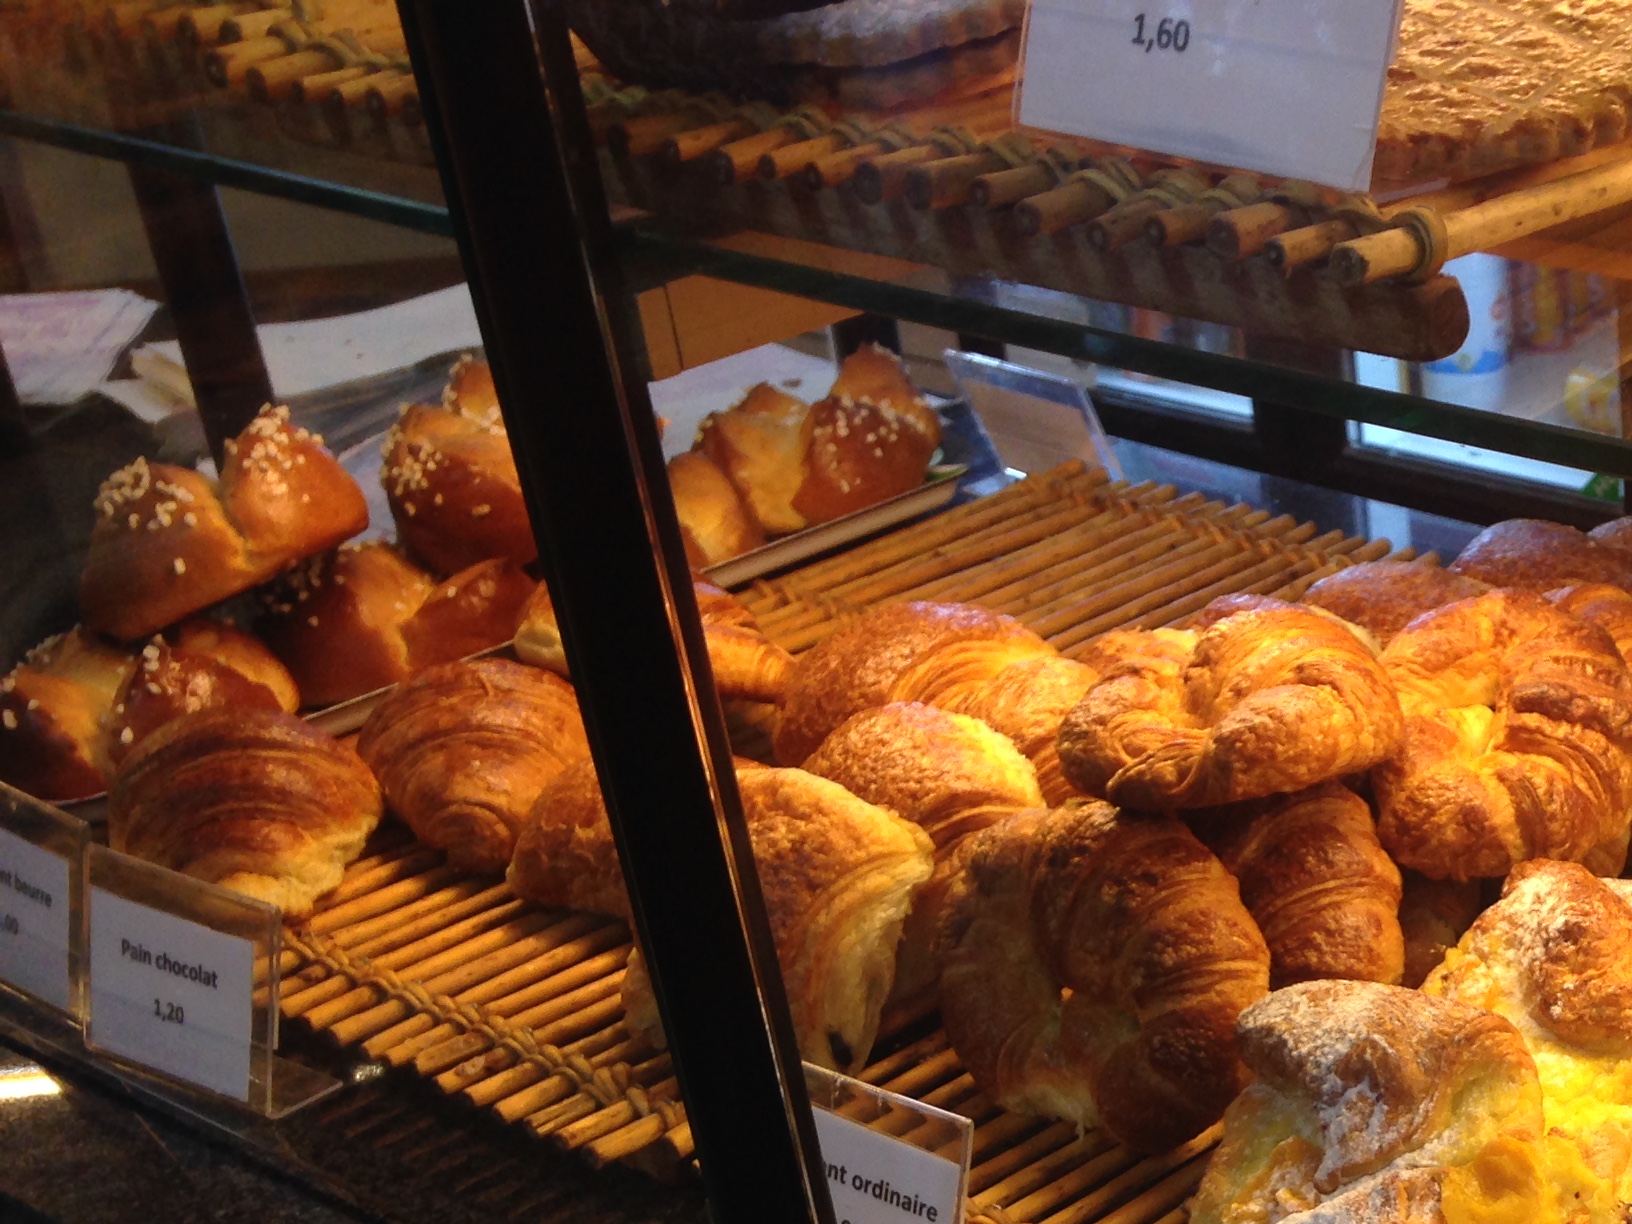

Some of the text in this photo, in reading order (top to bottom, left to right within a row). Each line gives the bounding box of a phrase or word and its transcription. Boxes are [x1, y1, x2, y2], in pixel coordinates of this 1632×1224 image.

[1131, 12, 1191, 54] 1,60
[121, 937, 219, 989] Pain chocolat
[153, 998, 185, 1026] 1,20
[851, 1174, 938, 1223] ordinaire
